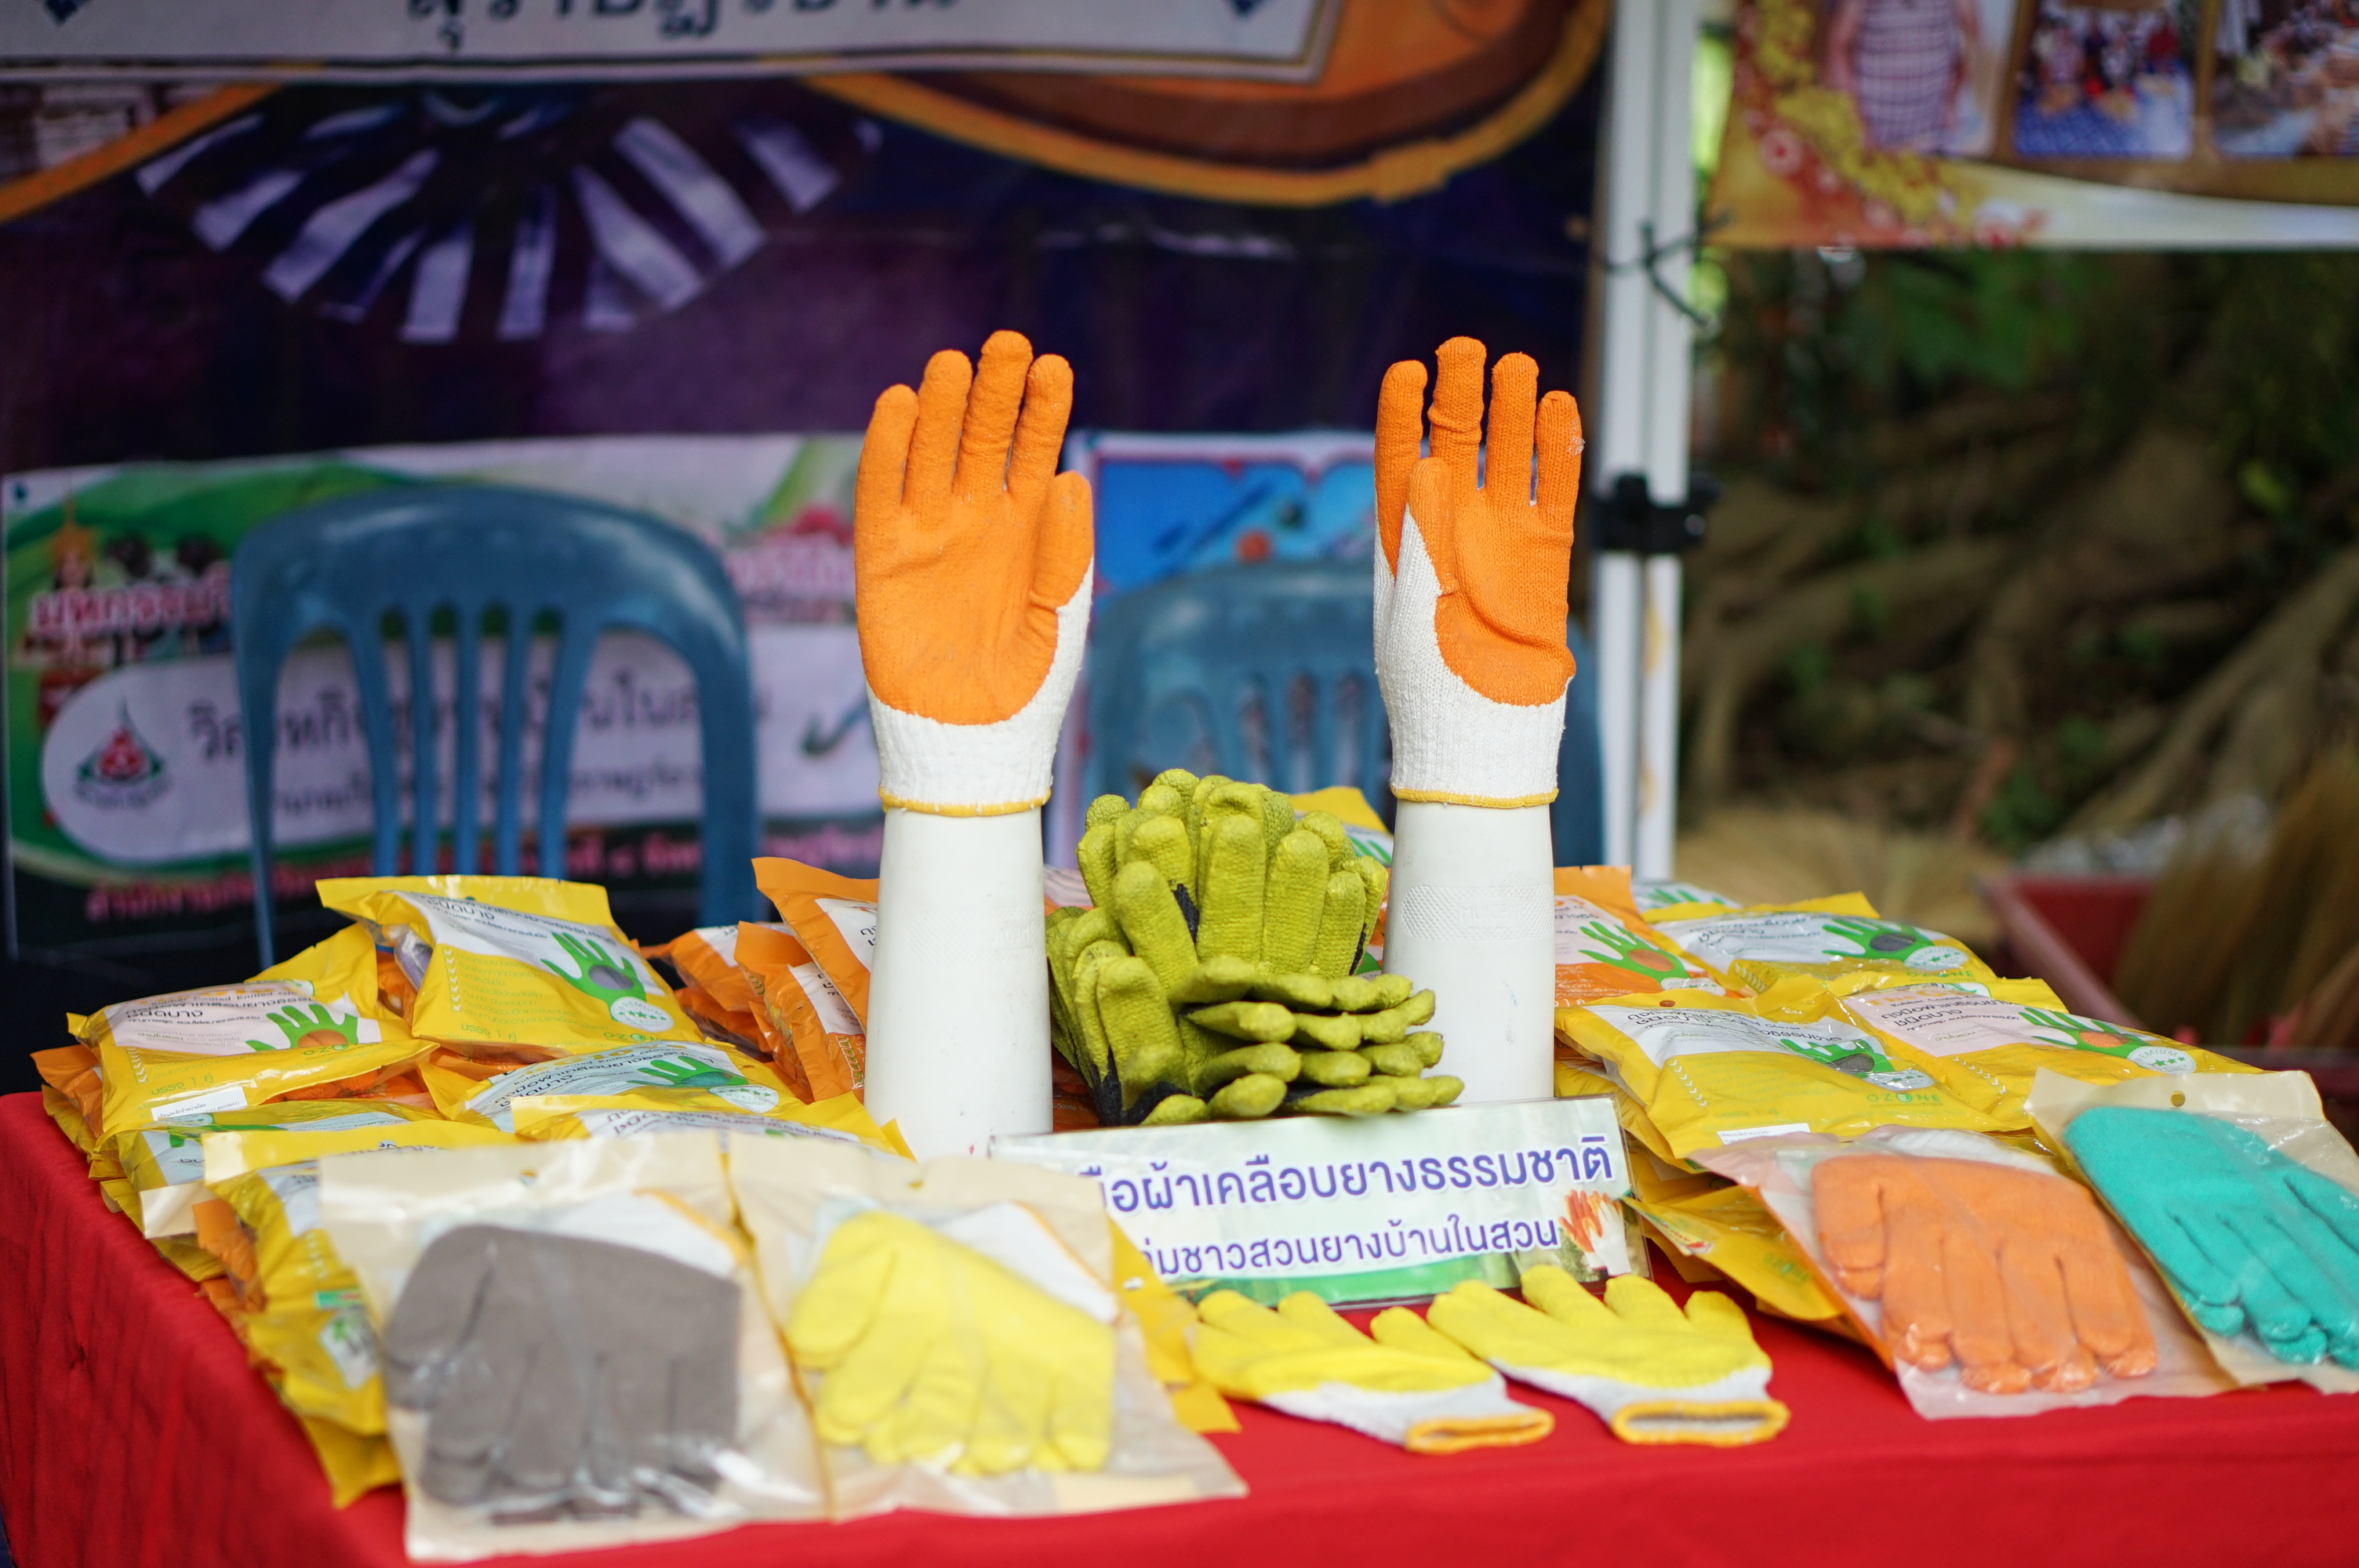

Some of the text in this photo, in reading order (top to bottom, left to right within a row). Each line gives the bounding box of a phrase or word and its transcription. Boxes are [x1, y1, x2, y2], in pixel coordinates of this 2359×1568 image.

[1078, 1135, 1613, 1213] ือผ้าเคลือบยางธรรมชาติ
[1140, 1213, 1559, 1275] ่มชาวสวนยางบ้านในสวน
